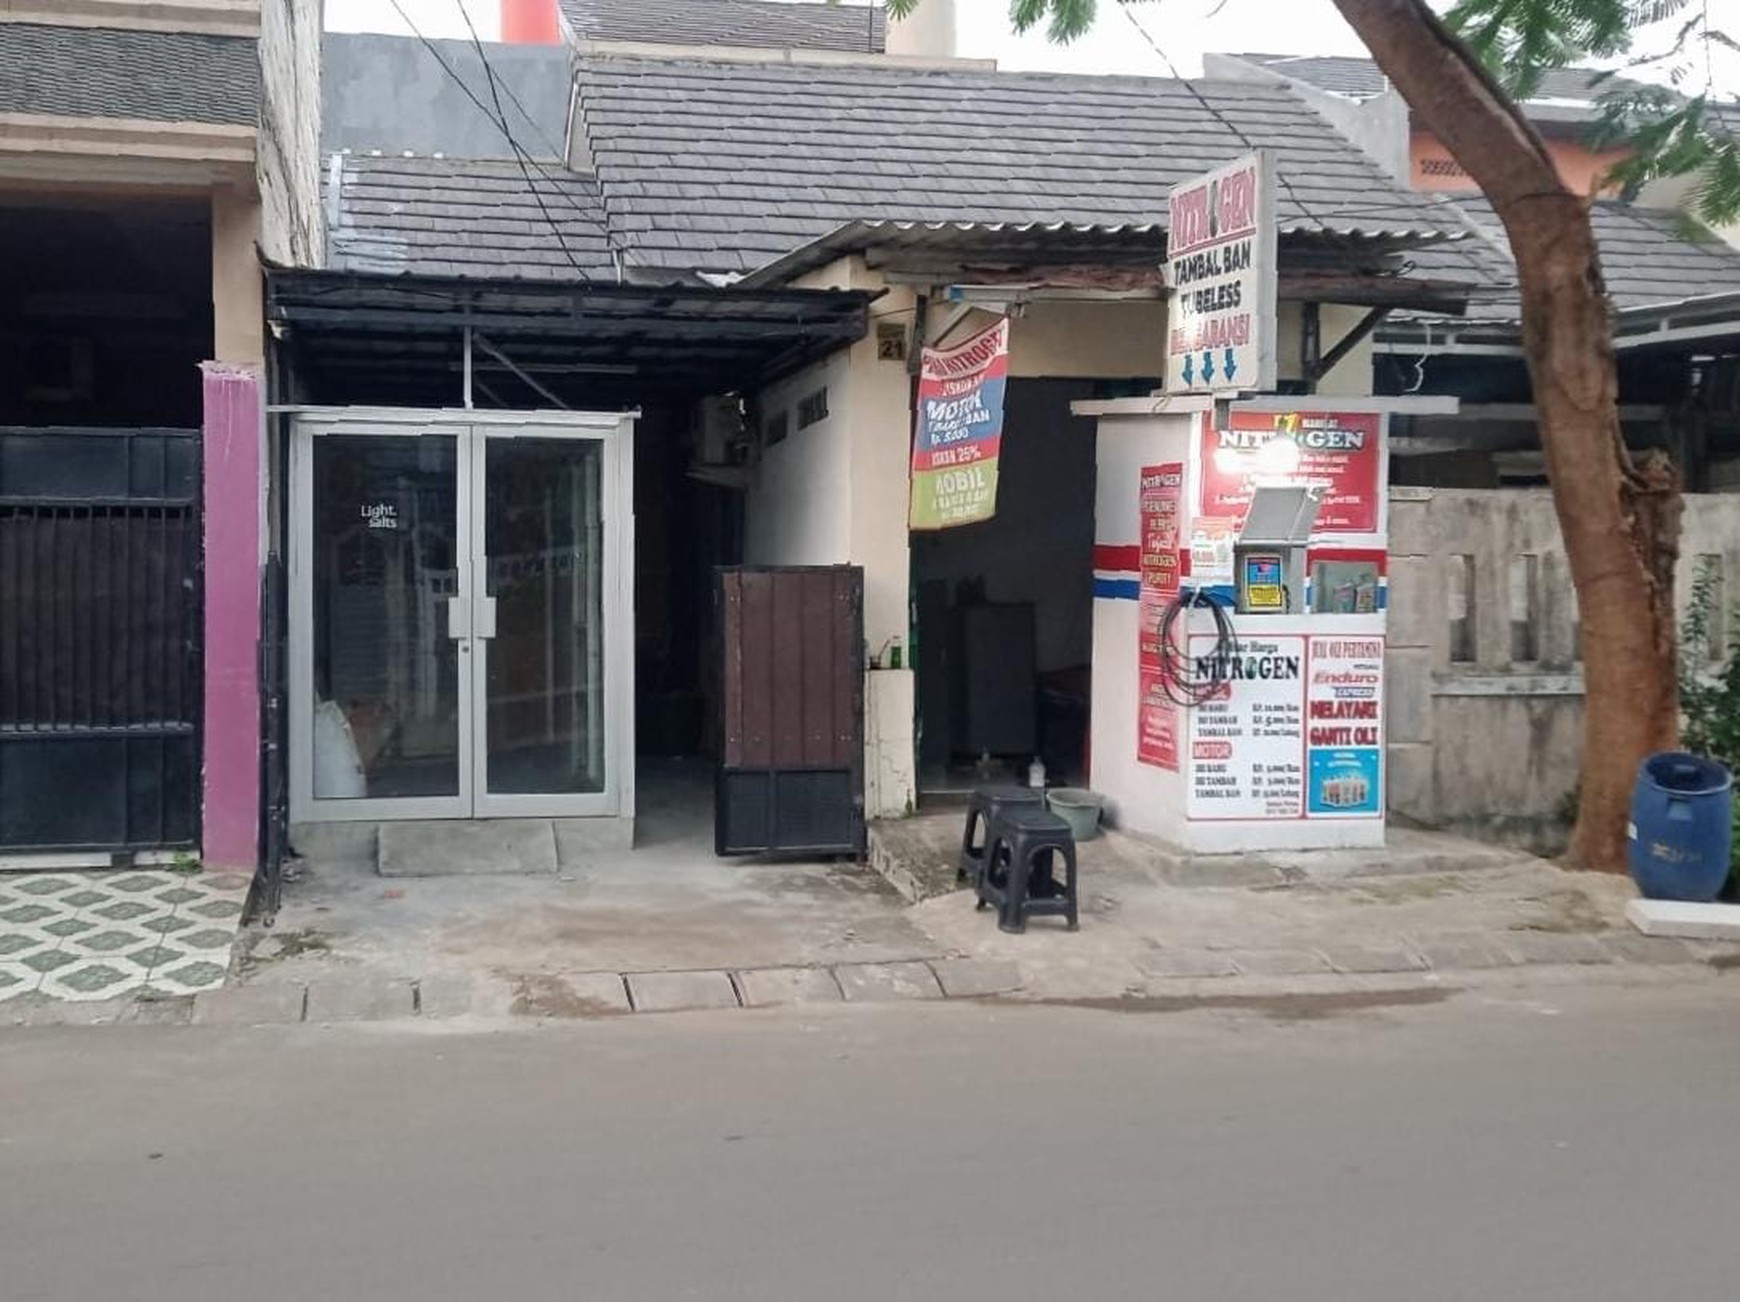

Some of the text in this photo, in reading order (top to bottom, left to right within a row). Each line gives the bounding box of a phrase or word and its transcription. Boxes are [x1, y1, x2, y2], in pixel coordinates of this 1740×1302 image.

[1174, 240, 1250, 286] TAMBAL BAN
[882, 340, 904, 358] 21
[1170, 313, 1250, 356] BEGARANSI
[1219, 430, 1364, 449] NITGEN
